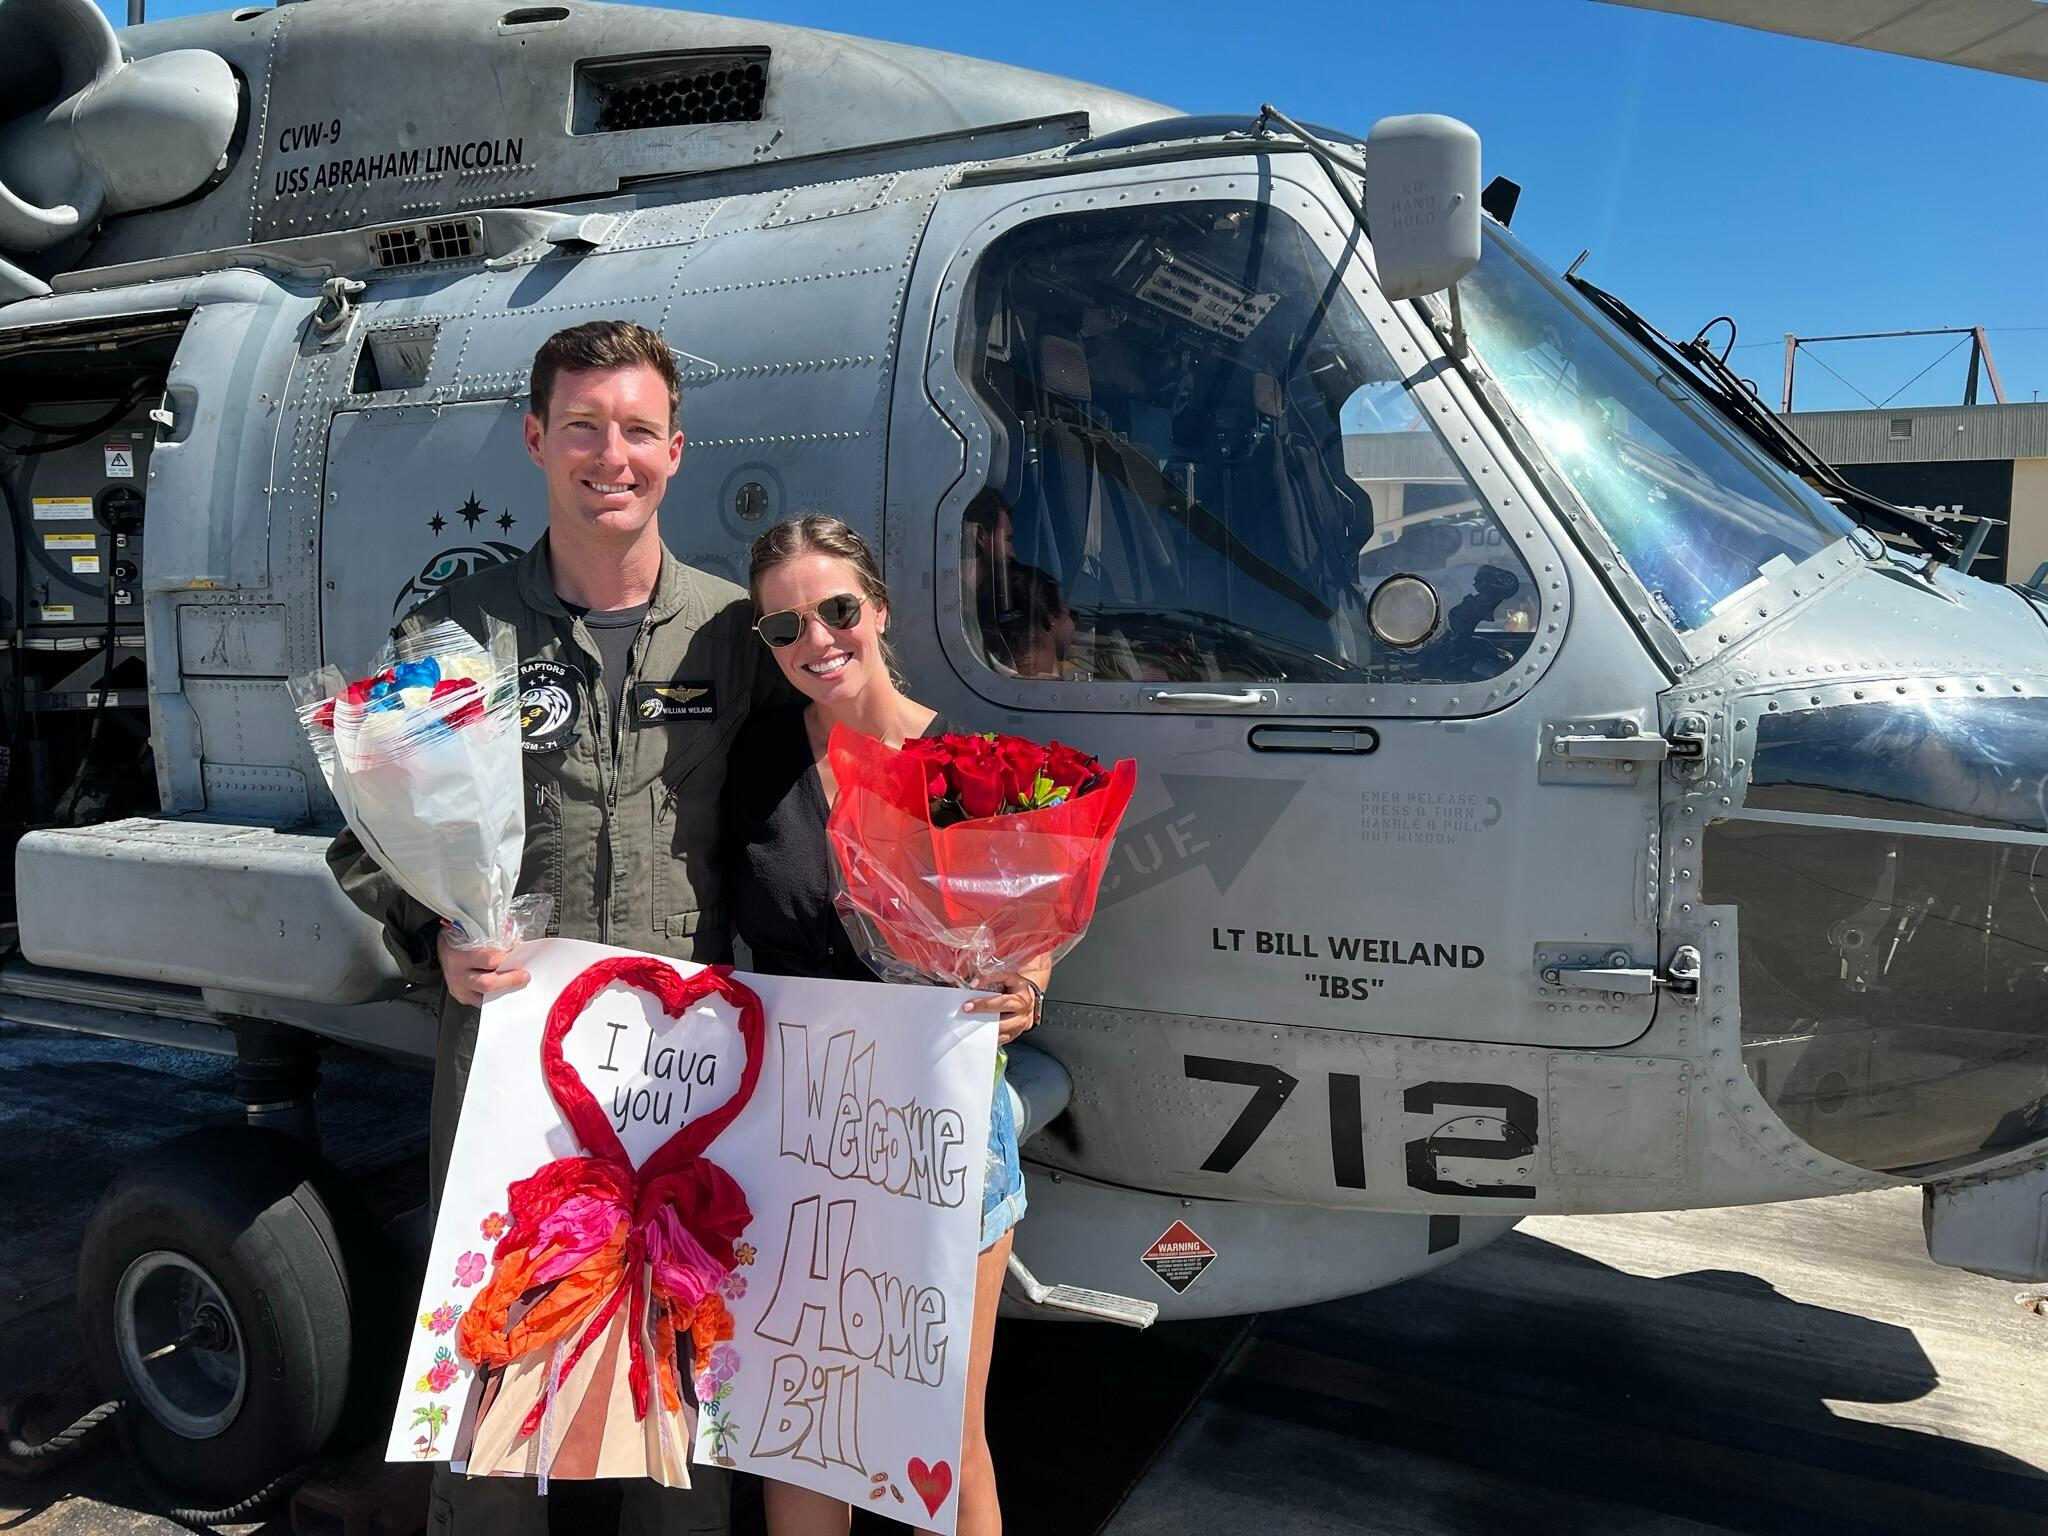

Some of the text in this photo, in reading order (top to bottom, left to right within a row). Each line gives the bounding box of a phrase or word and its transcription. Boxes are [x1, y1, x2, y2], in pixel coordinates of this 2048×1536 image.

[279, 119, 341, 153] CVW-9
[275, 138, 523, 195] USS ABRAHAM LINCOLN
[521, 662, 566, 676] RAPTORS
[1361, 804, 1411, 816] PRESS
[1433, 806, 1474, 819] TURN
[1407, 792, 1478, 806] RELEASE
[1361, 818, 1422, 830] HANDLE
[1443, 820, 1483, 833] PULL
[1361, 830, 1390, 841] OUT
[1212, 927, 1486, 969] LT BILL WEILAND
[1304, 973, 1385, 1001] "IBS"
[597, 1021, 629, 1073] I
[613, 1082, 692, 1133] you!
[1184, 1054, 1539, 1200] 712
[1158, 1242, 1200, 1252] WARNING
[749, 1353, 868, 1478] Bill
